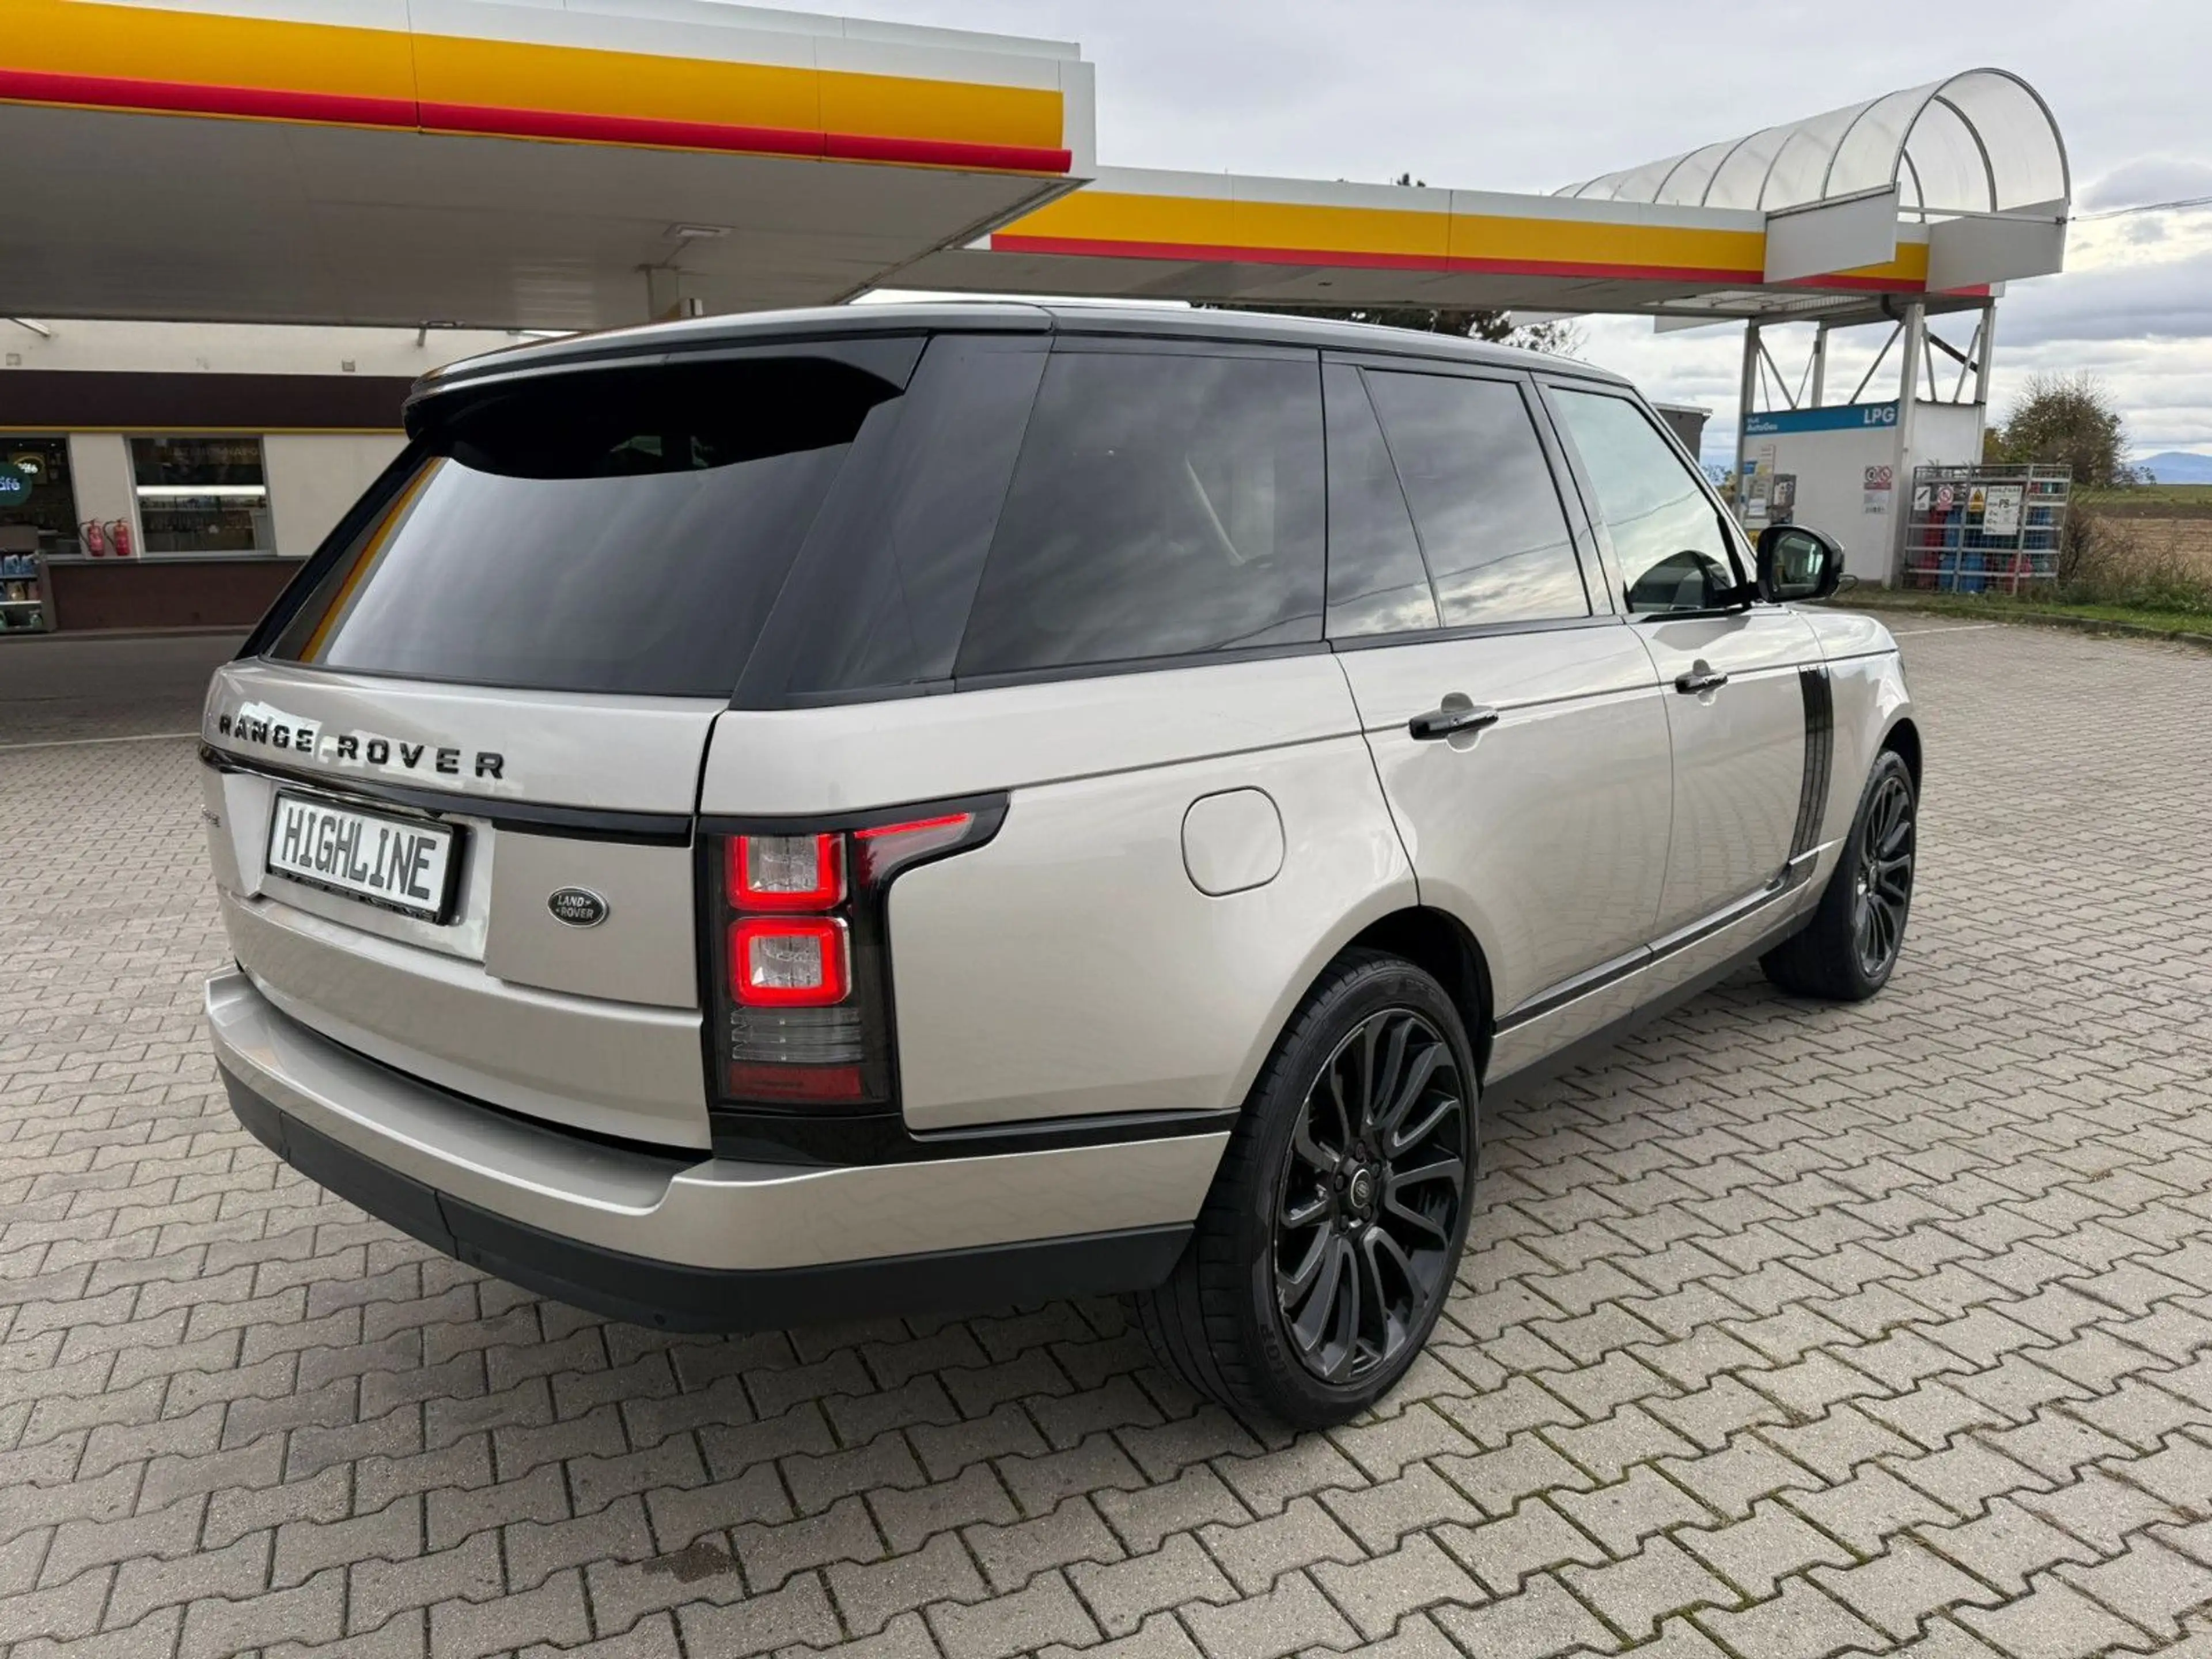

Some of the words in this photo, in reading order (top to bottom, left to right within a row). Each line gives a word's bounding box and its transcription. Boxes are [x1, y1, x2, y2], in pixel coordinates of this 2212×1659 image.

[1863, 406, 1895, 425] LPG
[218, 713, 314, 753] RANGE
[337, 734, 505, 779] ROVER
[281, 806, 437, 900] HIGHLINE
